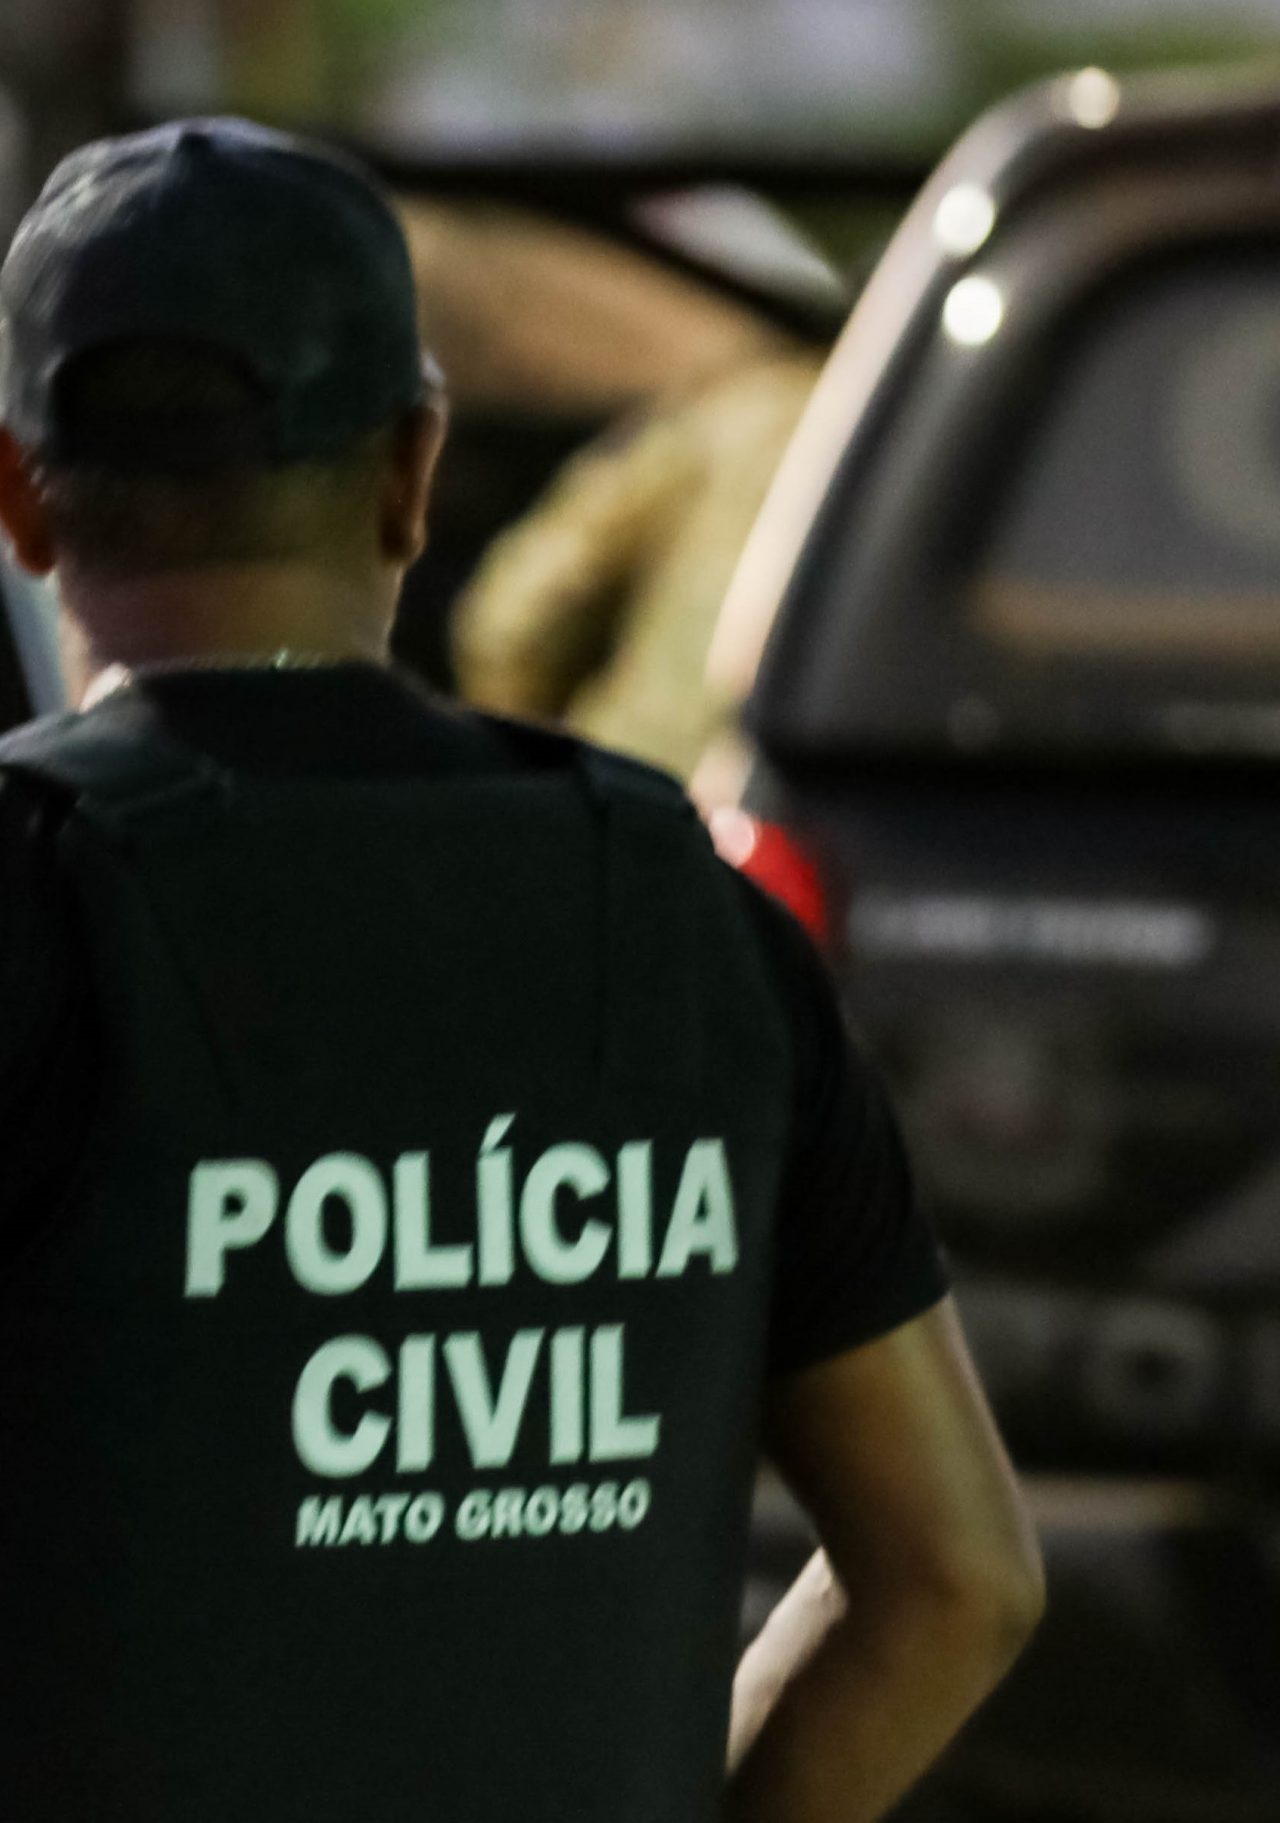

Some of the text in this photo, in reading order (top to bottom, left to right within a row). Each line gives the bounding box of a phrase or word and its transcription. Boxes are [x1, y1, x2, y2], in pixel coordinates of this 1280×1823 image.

[184, 1113, 740, 1298] POLÍCIA
[291, 1323, 661, 1479] CIVIL
[294, 1479, 652, 1548] MATO GROSSO
